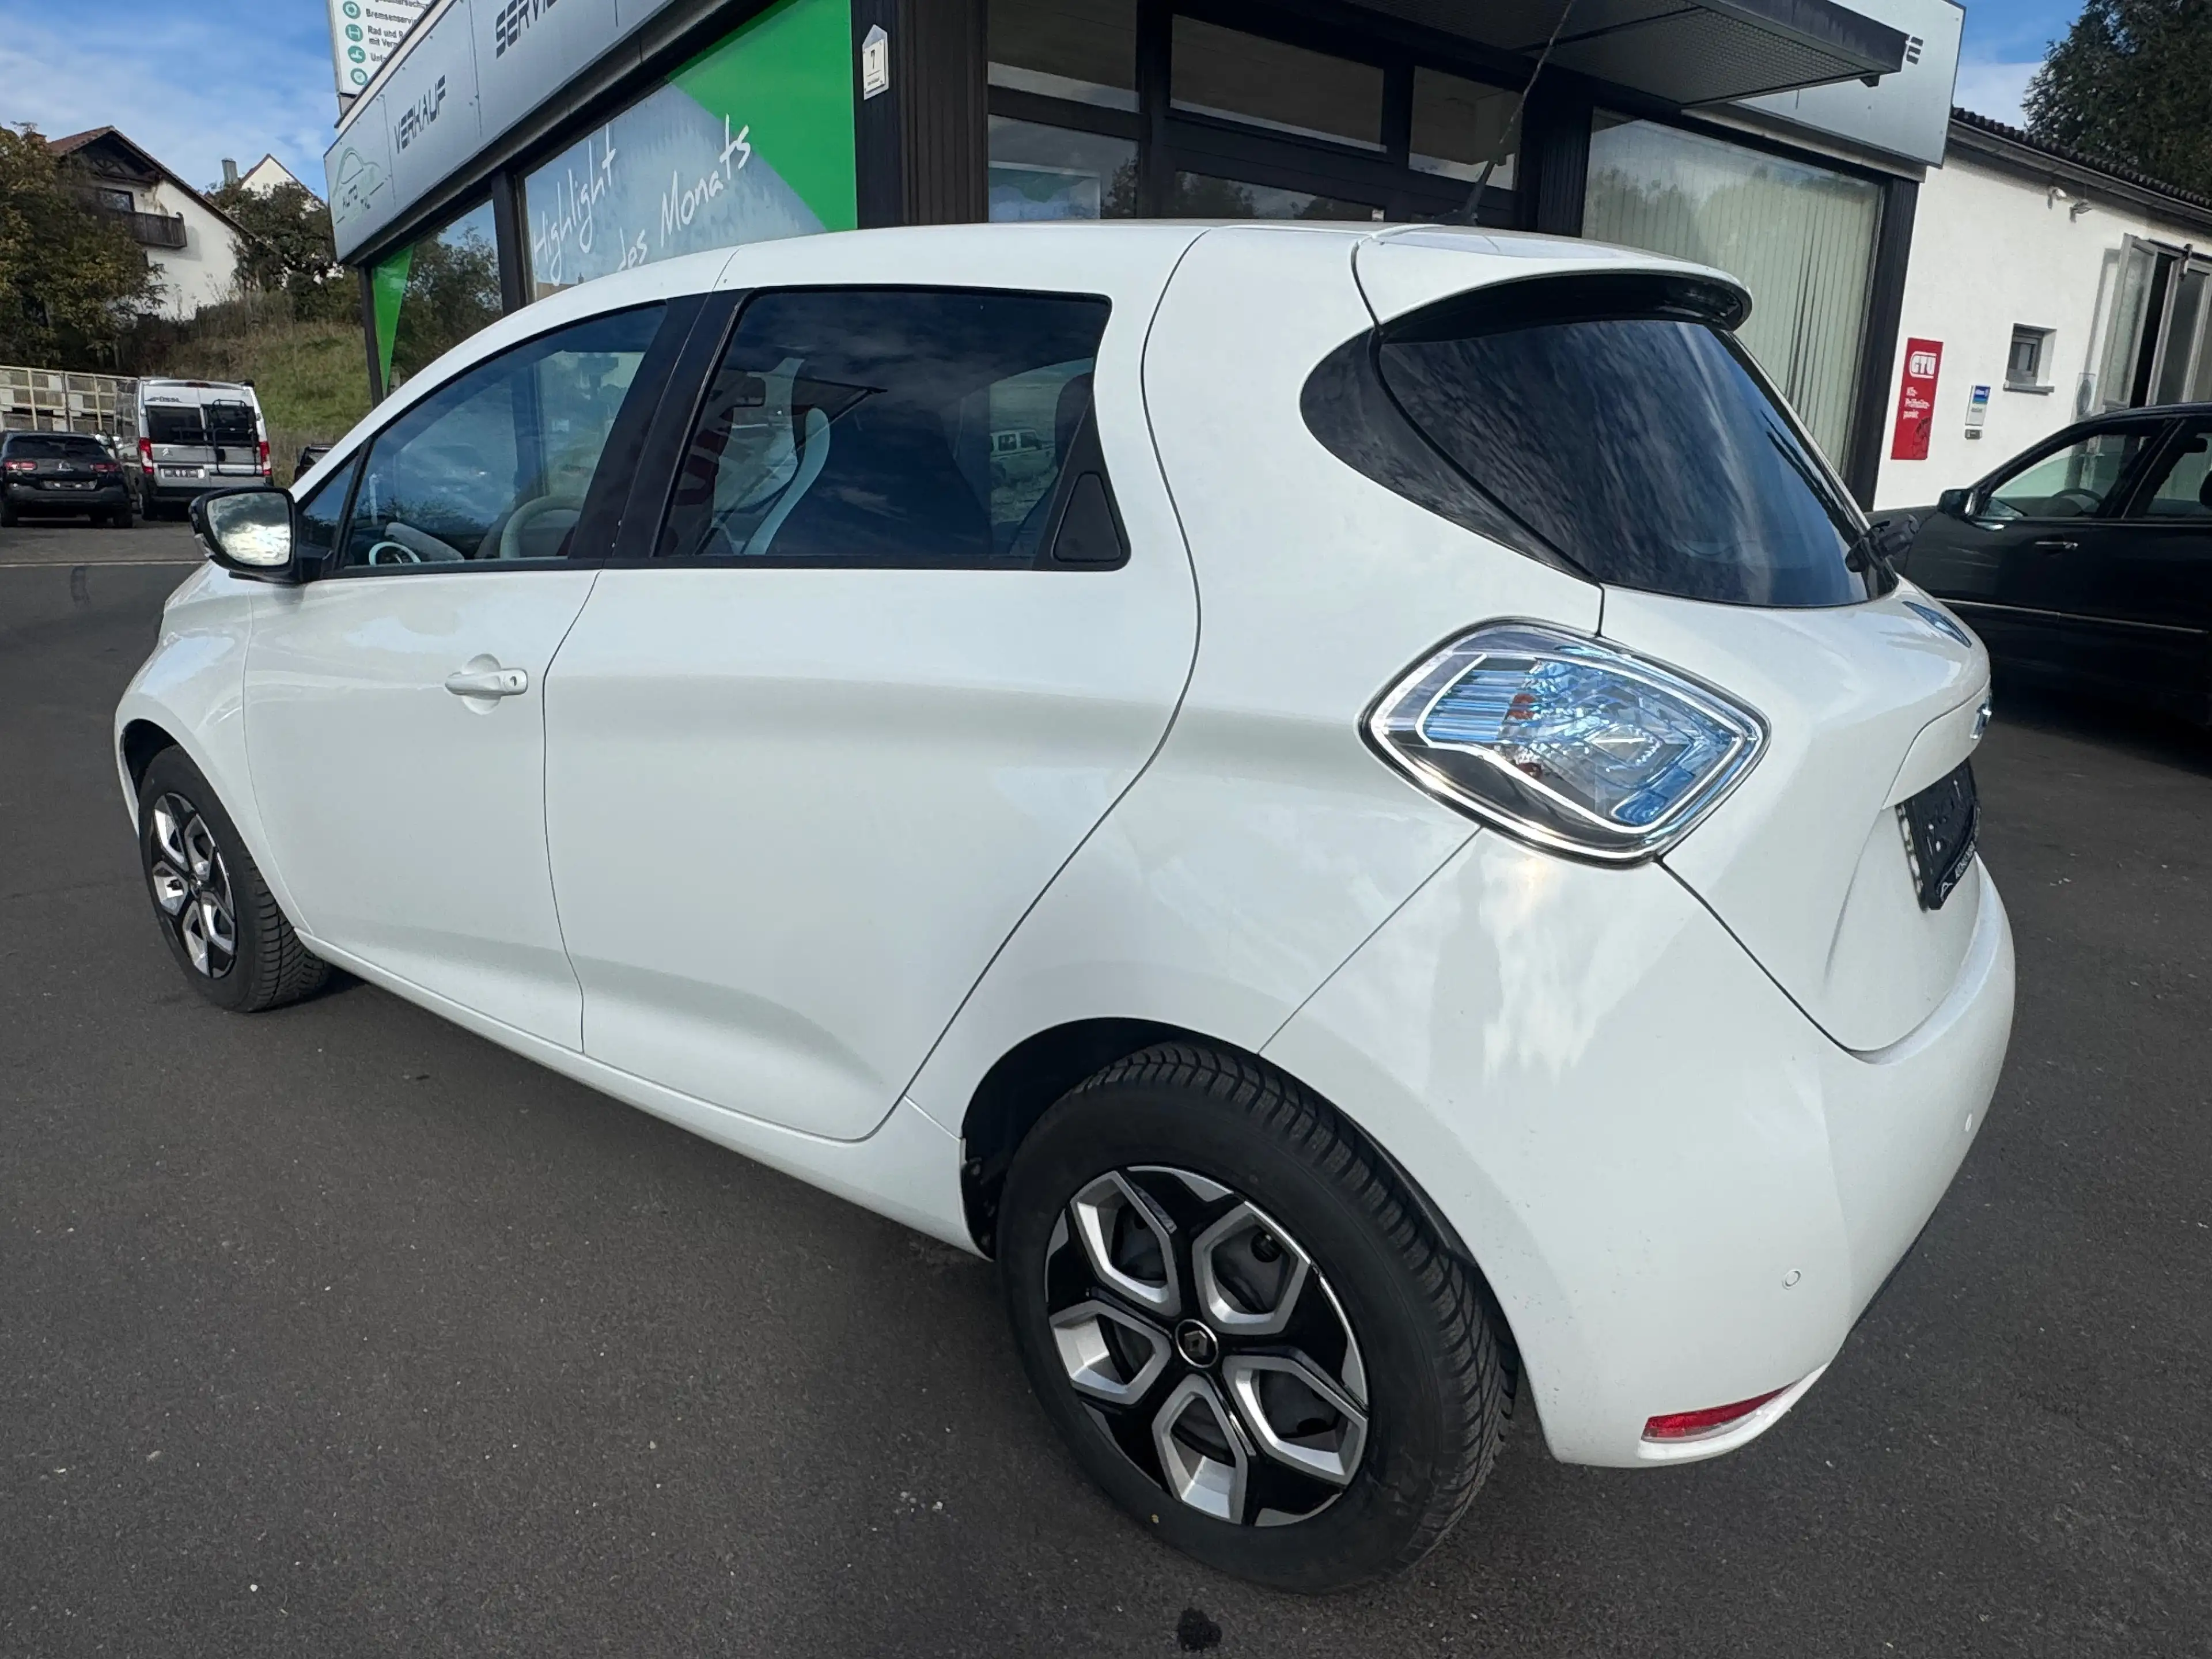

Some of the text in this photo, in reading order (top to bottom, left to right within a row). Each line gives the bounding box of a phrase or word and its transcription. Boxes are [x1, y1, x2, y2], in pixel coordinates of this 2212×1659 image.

[394, 74, 446, 154] VERKAUF
[661, 113, 751, 248] Monats
[533, 123, 616, 286] Highlight
